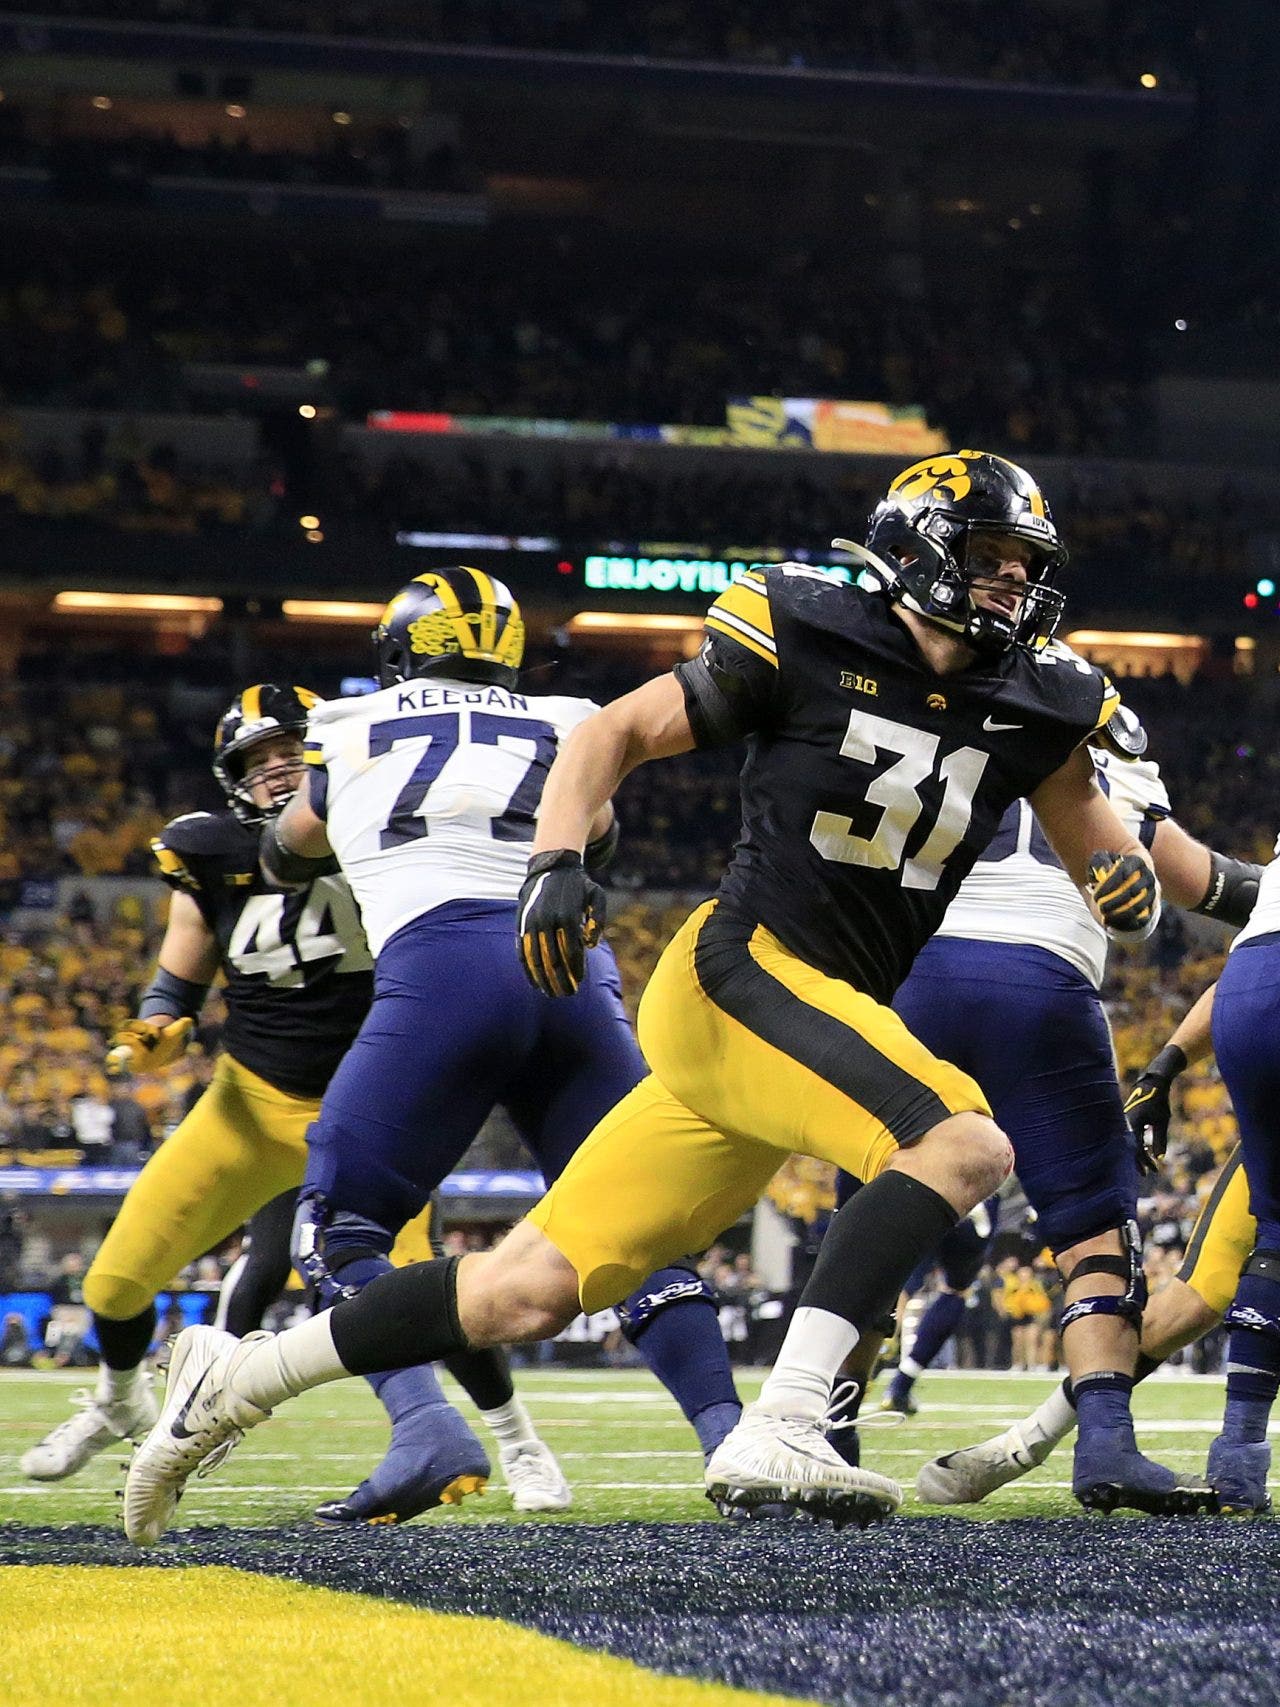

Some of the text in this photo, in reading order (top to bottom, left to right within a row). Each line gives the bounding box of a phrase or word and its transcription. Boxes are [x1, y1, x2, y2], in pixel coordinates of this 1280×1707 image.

[368, 711, 558, 851] 77
[809, 708, 990, 891] 31
[228, 872, 376, 989] 44
